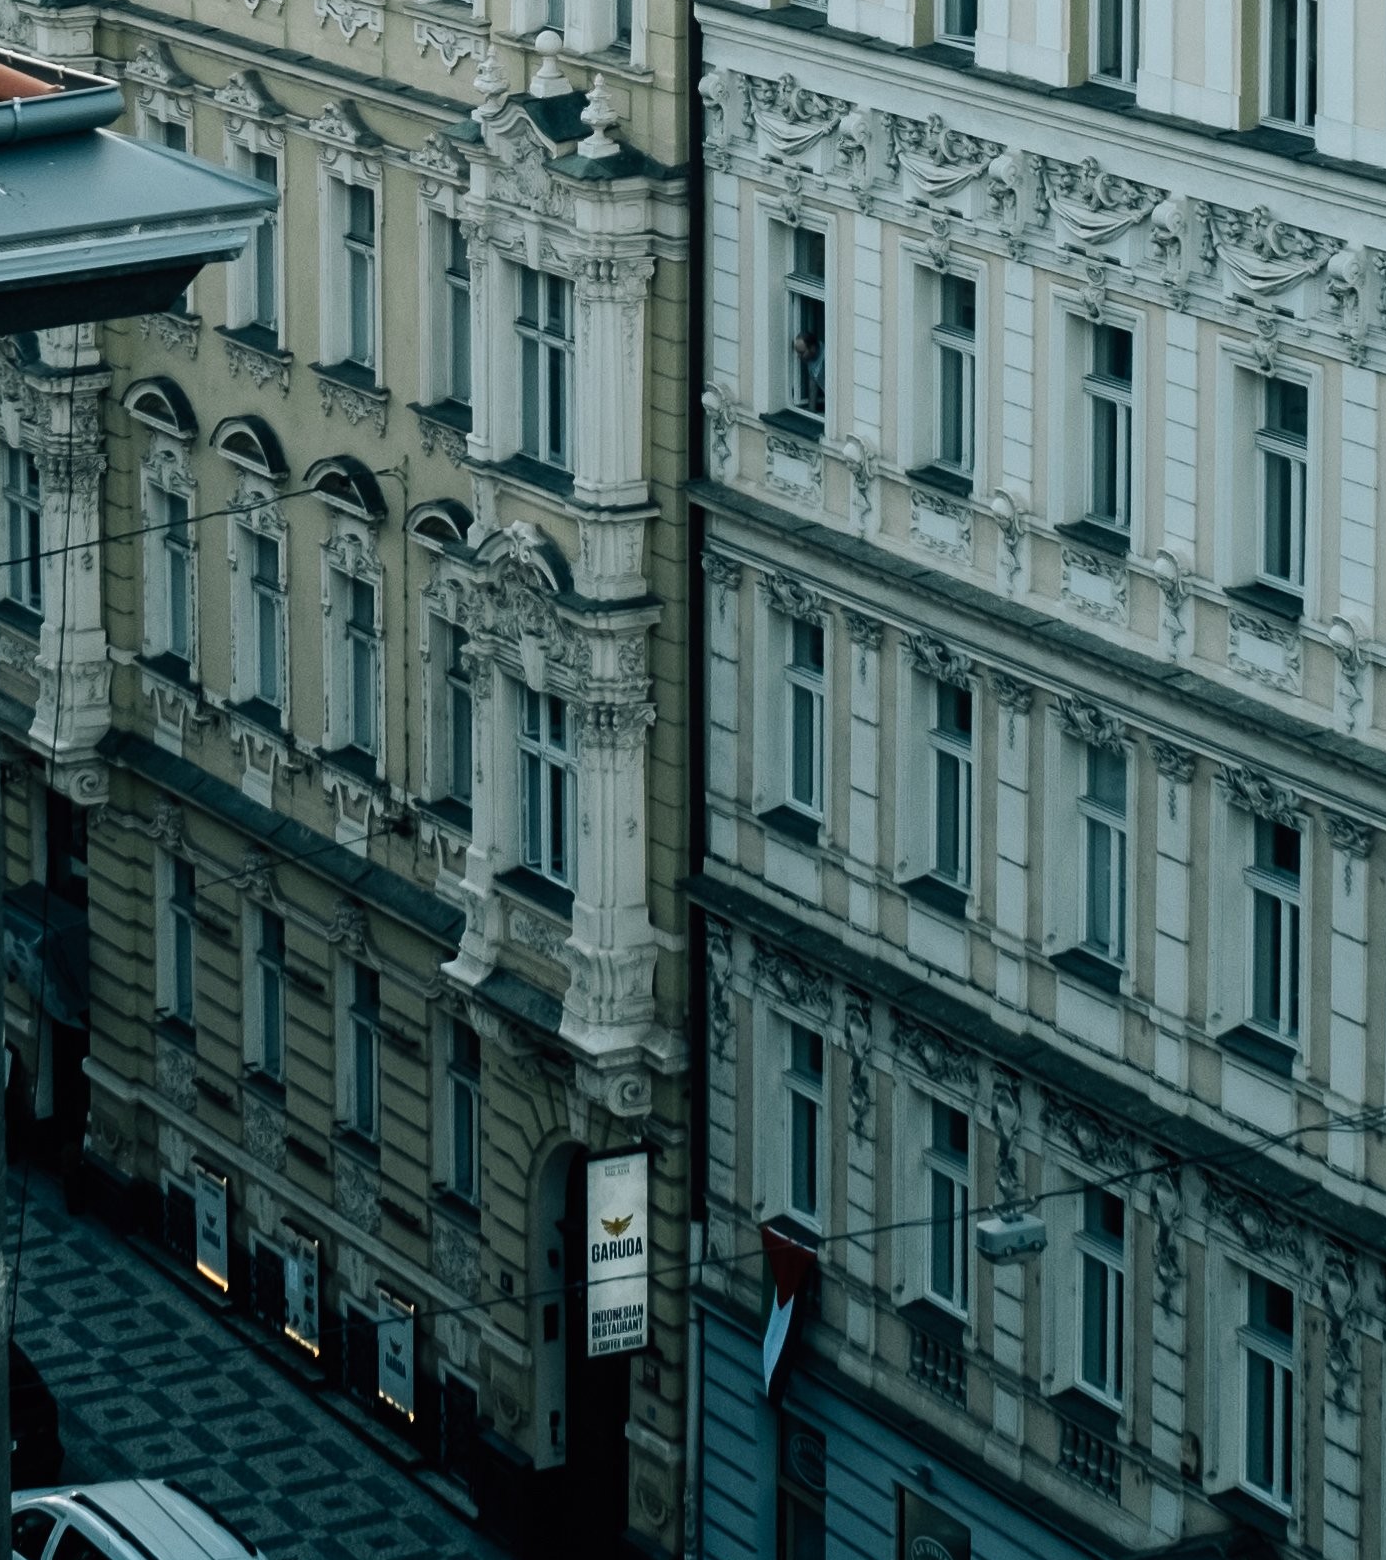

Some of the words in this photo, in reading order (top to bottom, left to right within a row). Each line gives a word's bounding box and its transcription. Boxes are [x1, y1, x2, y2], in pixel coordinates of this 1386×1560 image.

[591, 1237, 643, 1263] GARUDA
[591, 1303, 644, 1324] INDONESIAN
[591, 1318, 643, 1339] RESTAURANT
